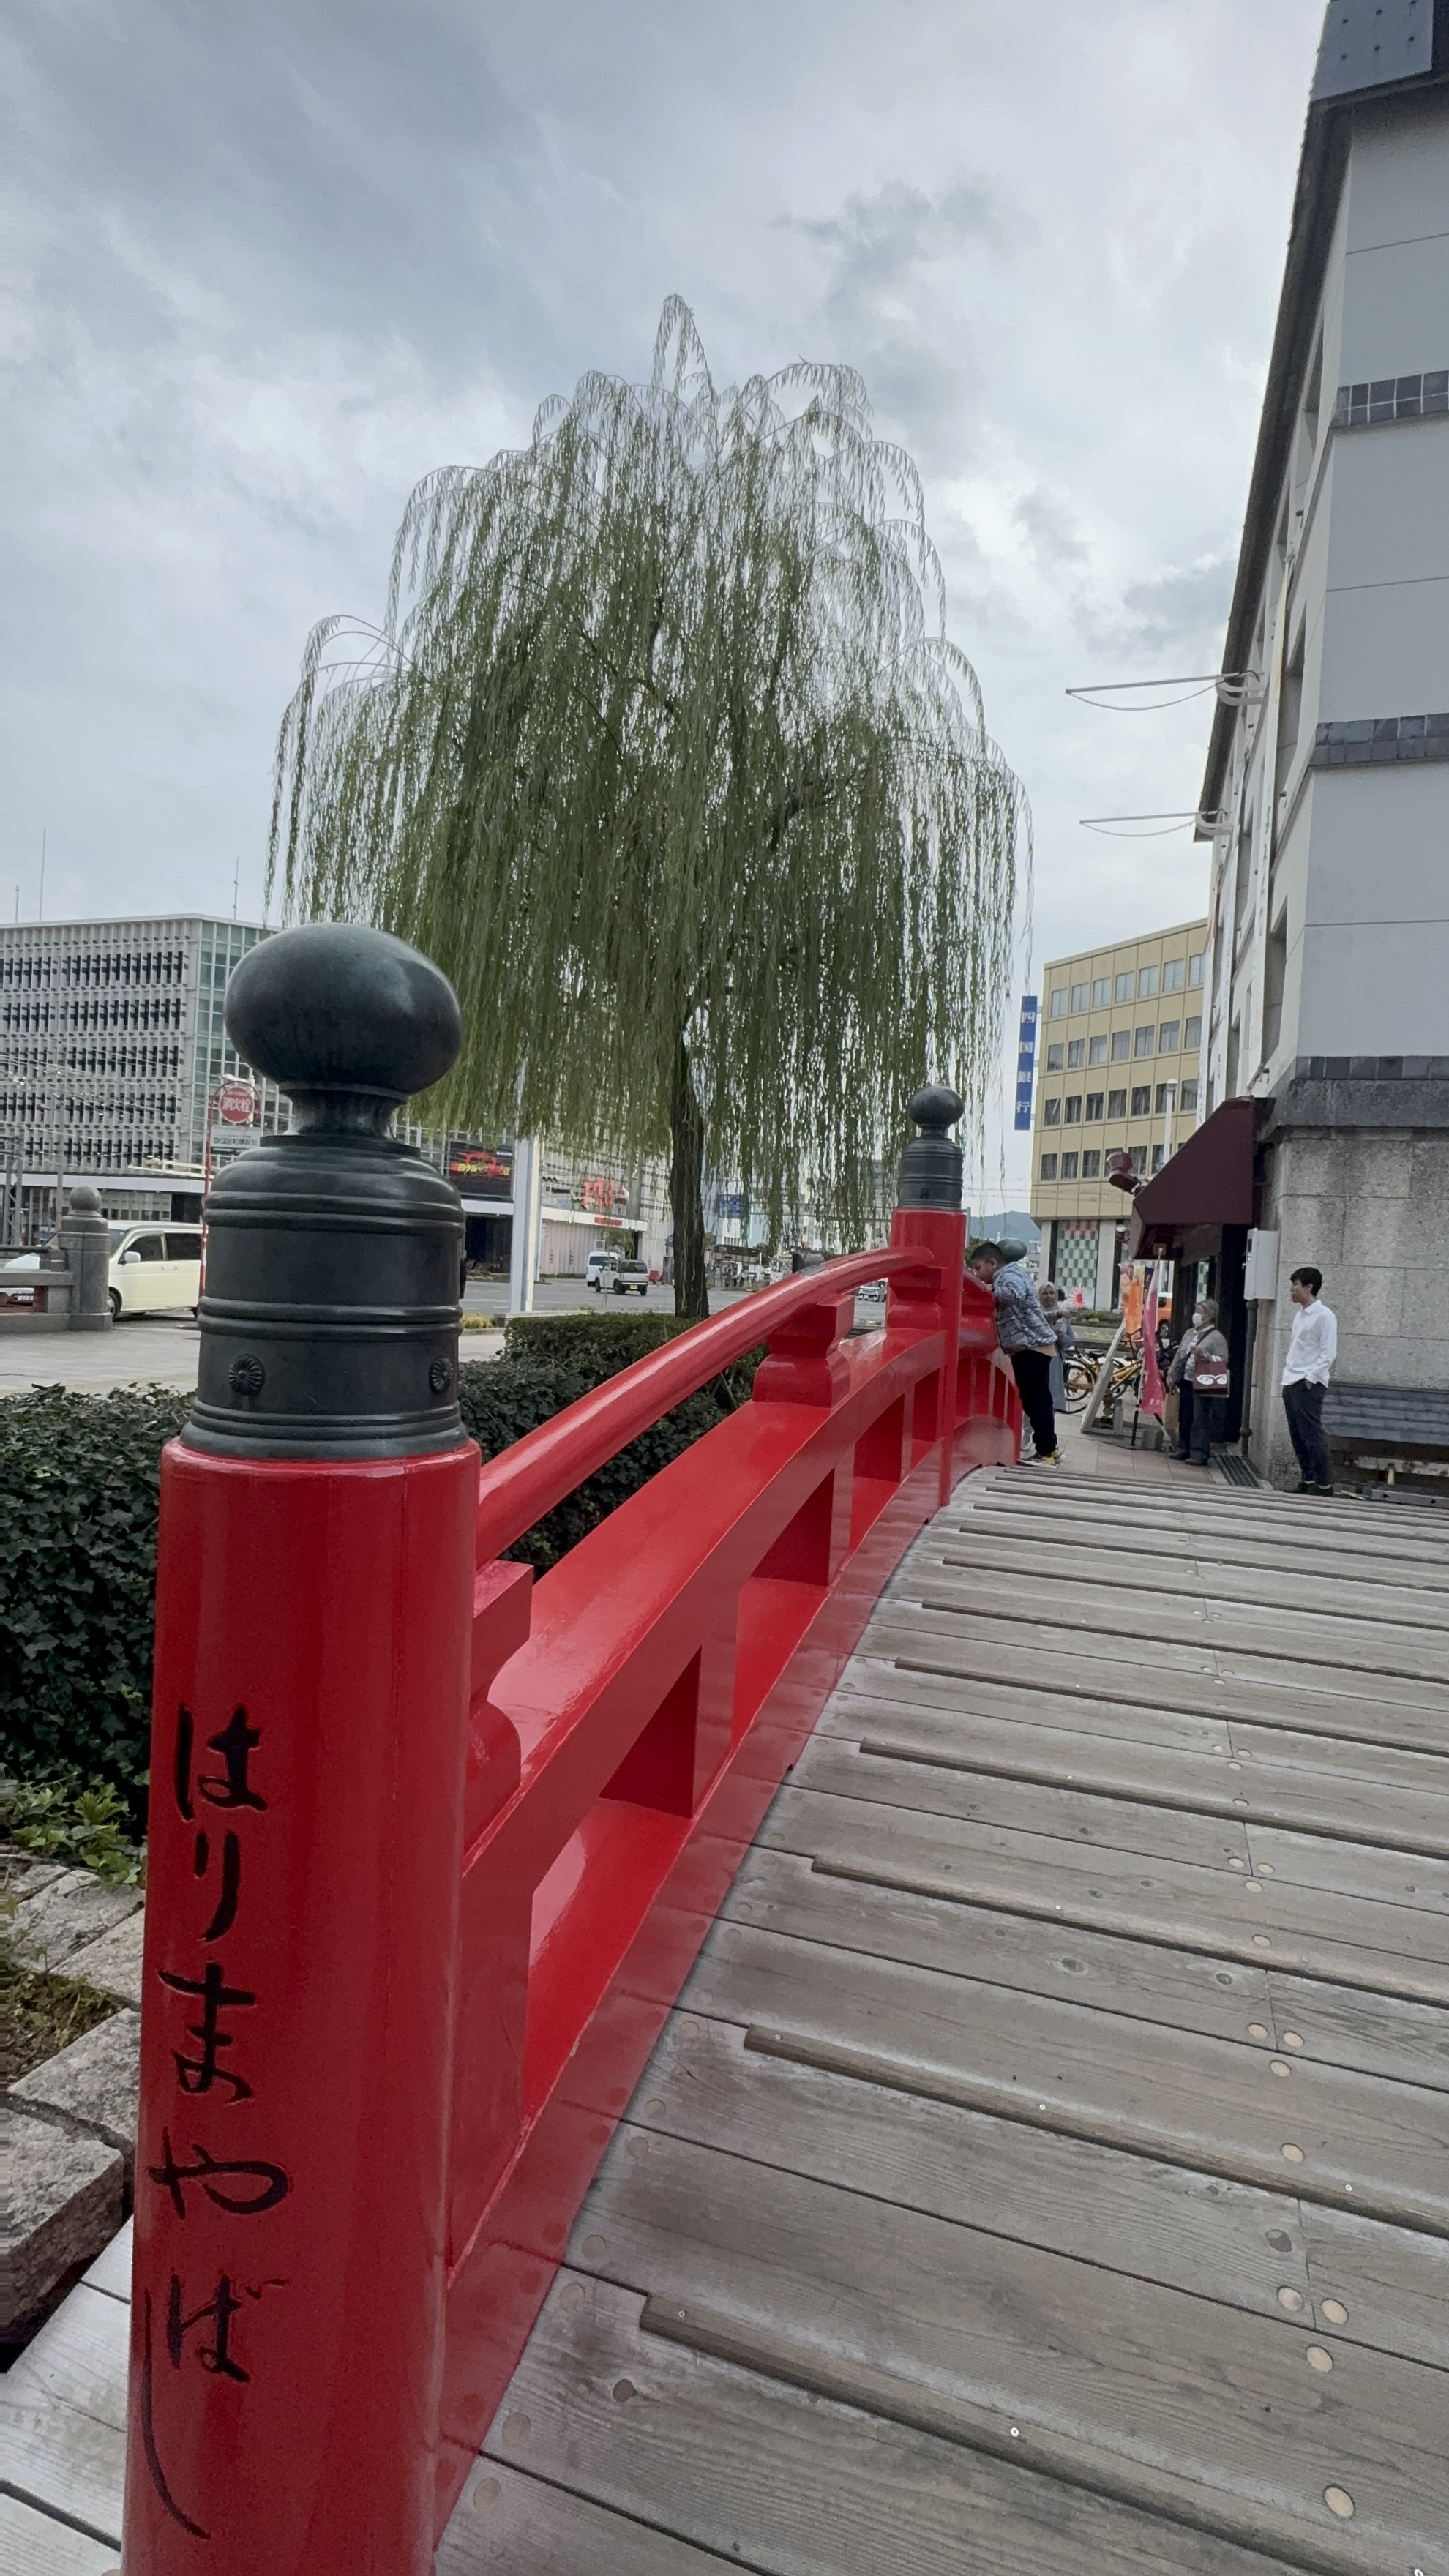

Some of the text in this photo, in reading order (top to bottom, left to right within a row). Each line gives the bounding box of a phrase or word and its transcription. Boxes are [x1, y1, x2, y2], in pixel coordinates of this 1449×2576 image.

[222, 1097, 251, 1112] 消火栓
[1016, 1011, 1036, 1113] 四国銀行
[142, 1703, 290, 2540] はりまやばし
